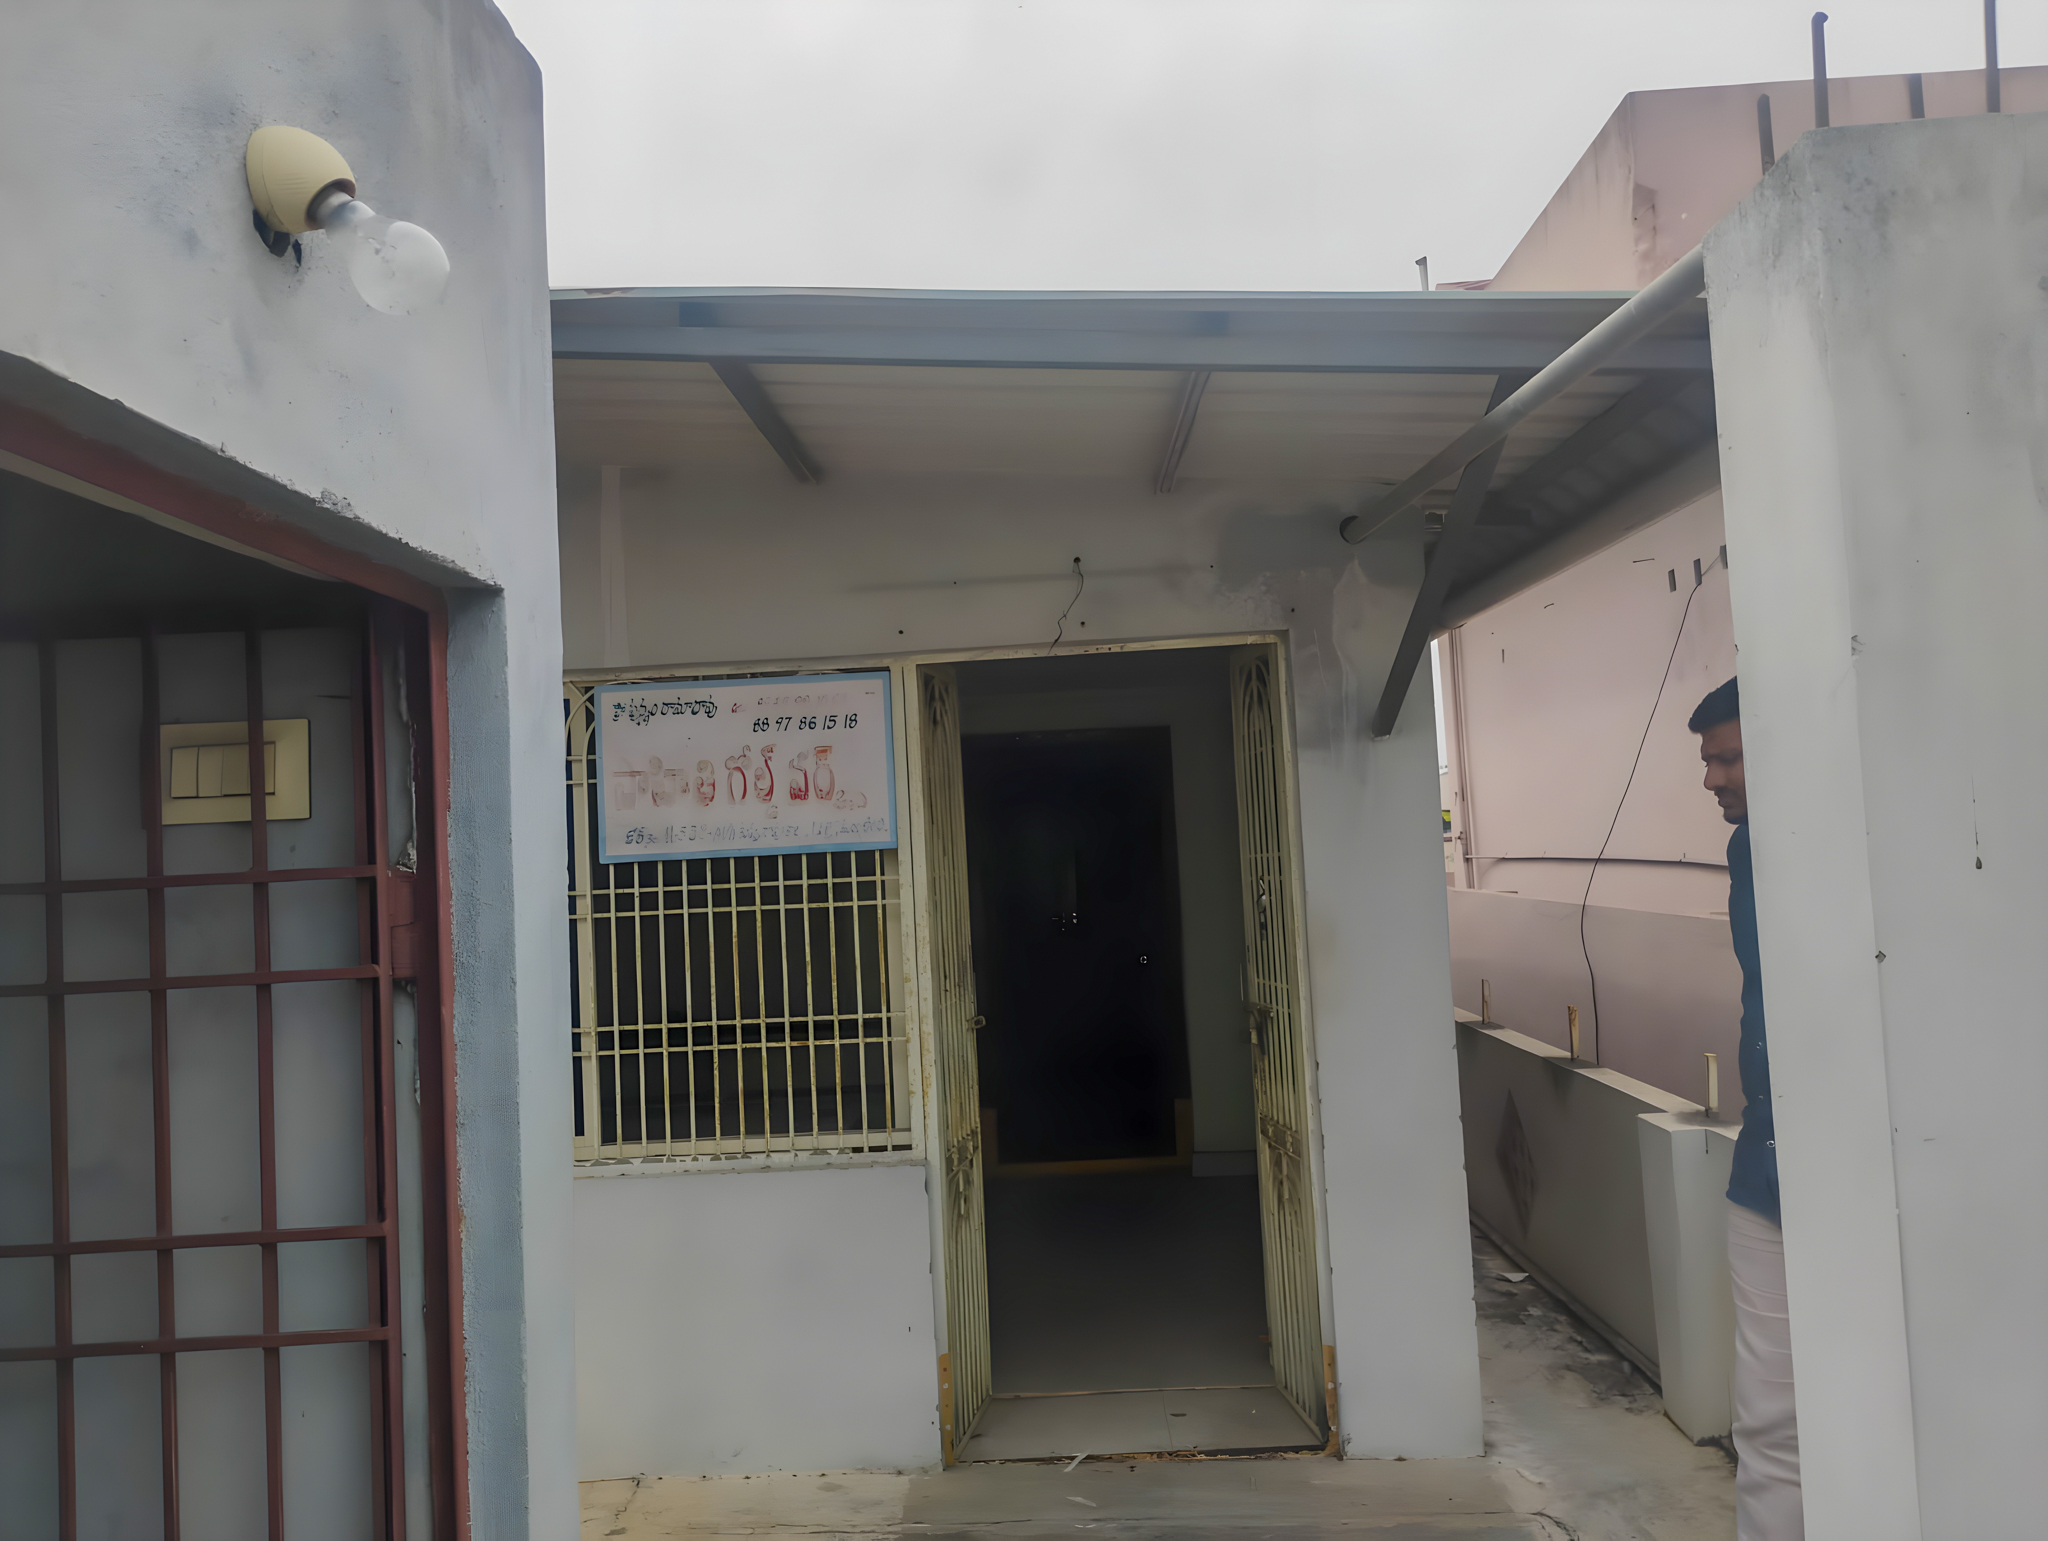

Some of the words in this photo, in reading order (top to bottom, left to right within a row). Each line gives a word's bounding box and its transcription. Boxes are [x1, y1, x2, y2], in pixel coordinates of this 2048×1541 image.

[775, 716, 793, 732] 97
[798, 716, 817, 731] 86
[822, 714, 839, 731] 15
[843, 713, 858, 729] 18
